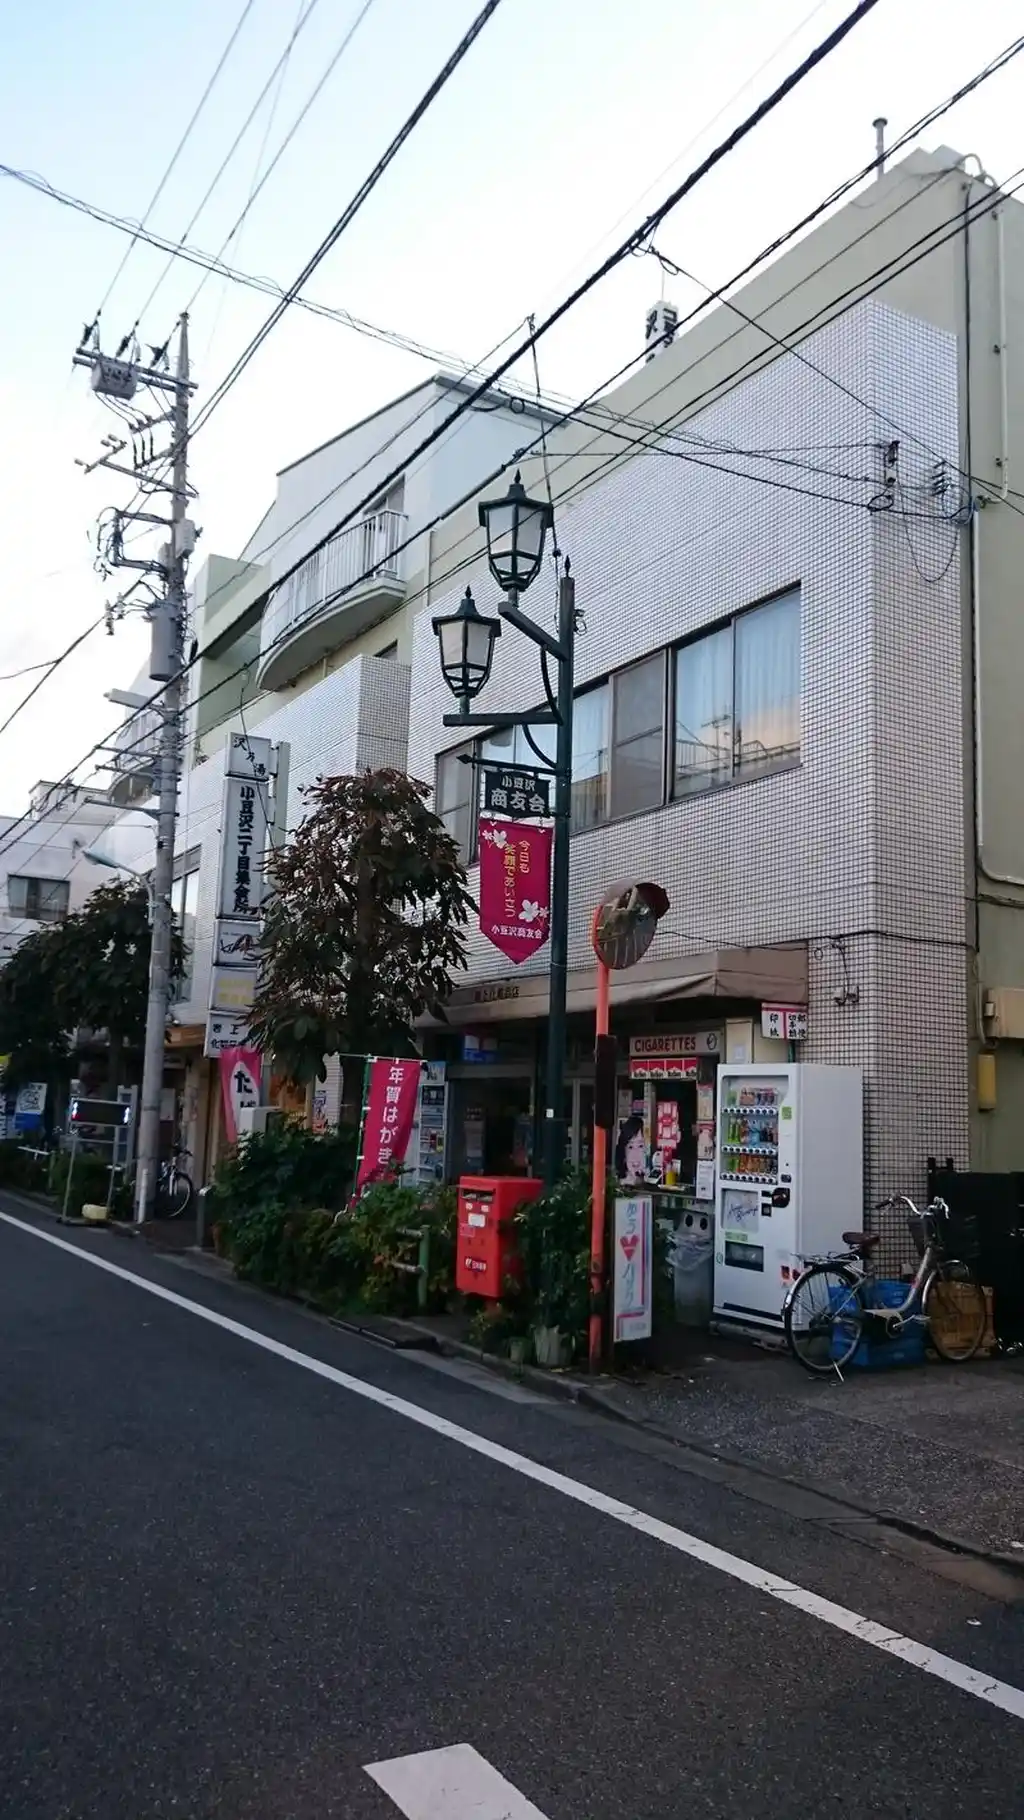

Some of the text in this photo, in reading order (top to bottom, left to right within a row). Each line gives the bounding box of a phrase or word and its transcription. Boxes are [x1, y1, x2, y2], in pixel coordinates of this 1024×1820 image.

[501, 775, 535, 791] 小豆沢
[490, 788, 545, 813] 商友会
[518, 840, 531, 874] 今日も
[491, 924, 543, 939] 小豆沢商友会
[634, 1036, 696, 1053] CIGARETTES
[377, 1066, 405, 1164] 年賀はがき
